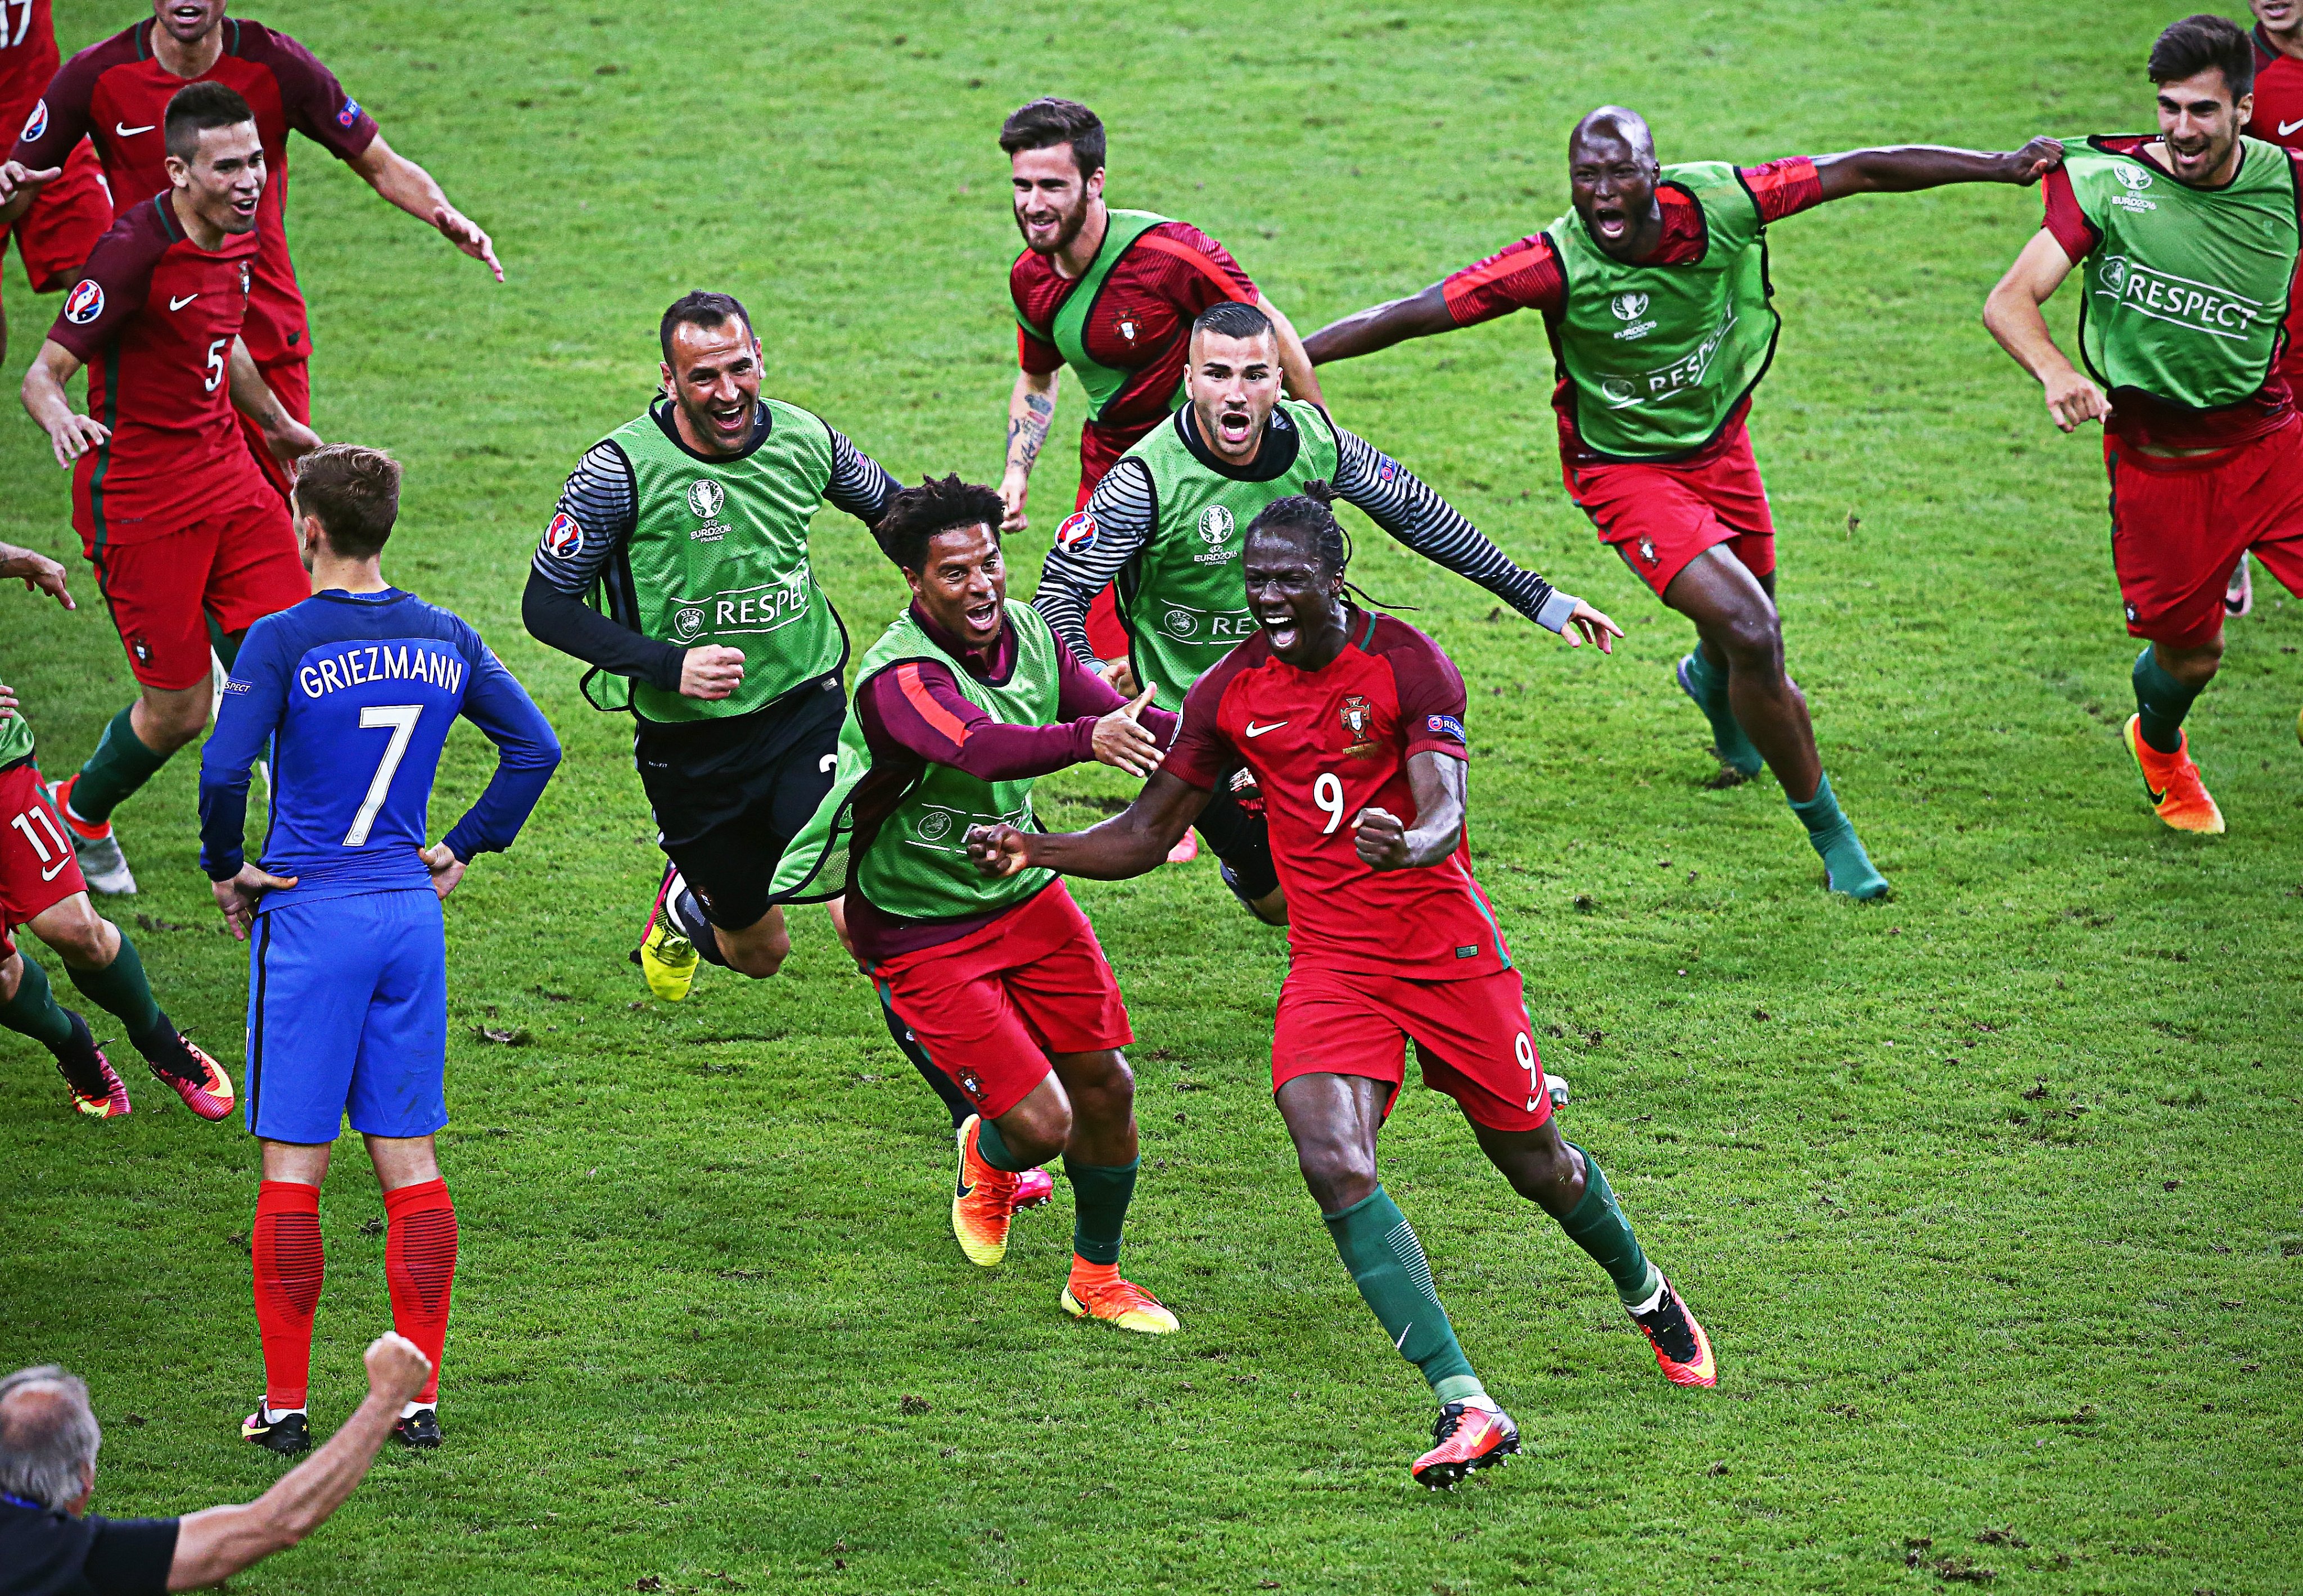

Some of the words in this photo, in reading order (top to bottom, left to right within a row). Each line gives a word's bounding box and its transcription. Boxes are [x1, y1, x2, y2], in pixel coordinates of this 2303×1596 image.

[2126, 274, 2257, 330] RESPECT
[205, 338, 226, 392] 5
[1194, 550, 1238, 562] EURO2016
[300, 646, 462, 698] GRIEZMANN
[342, 704, 424, 847] 7
[1313, 772, 1344, 834] 9
[11, 805, 69, 863] 11
[1515, 1031, 1538, 1092] 9
